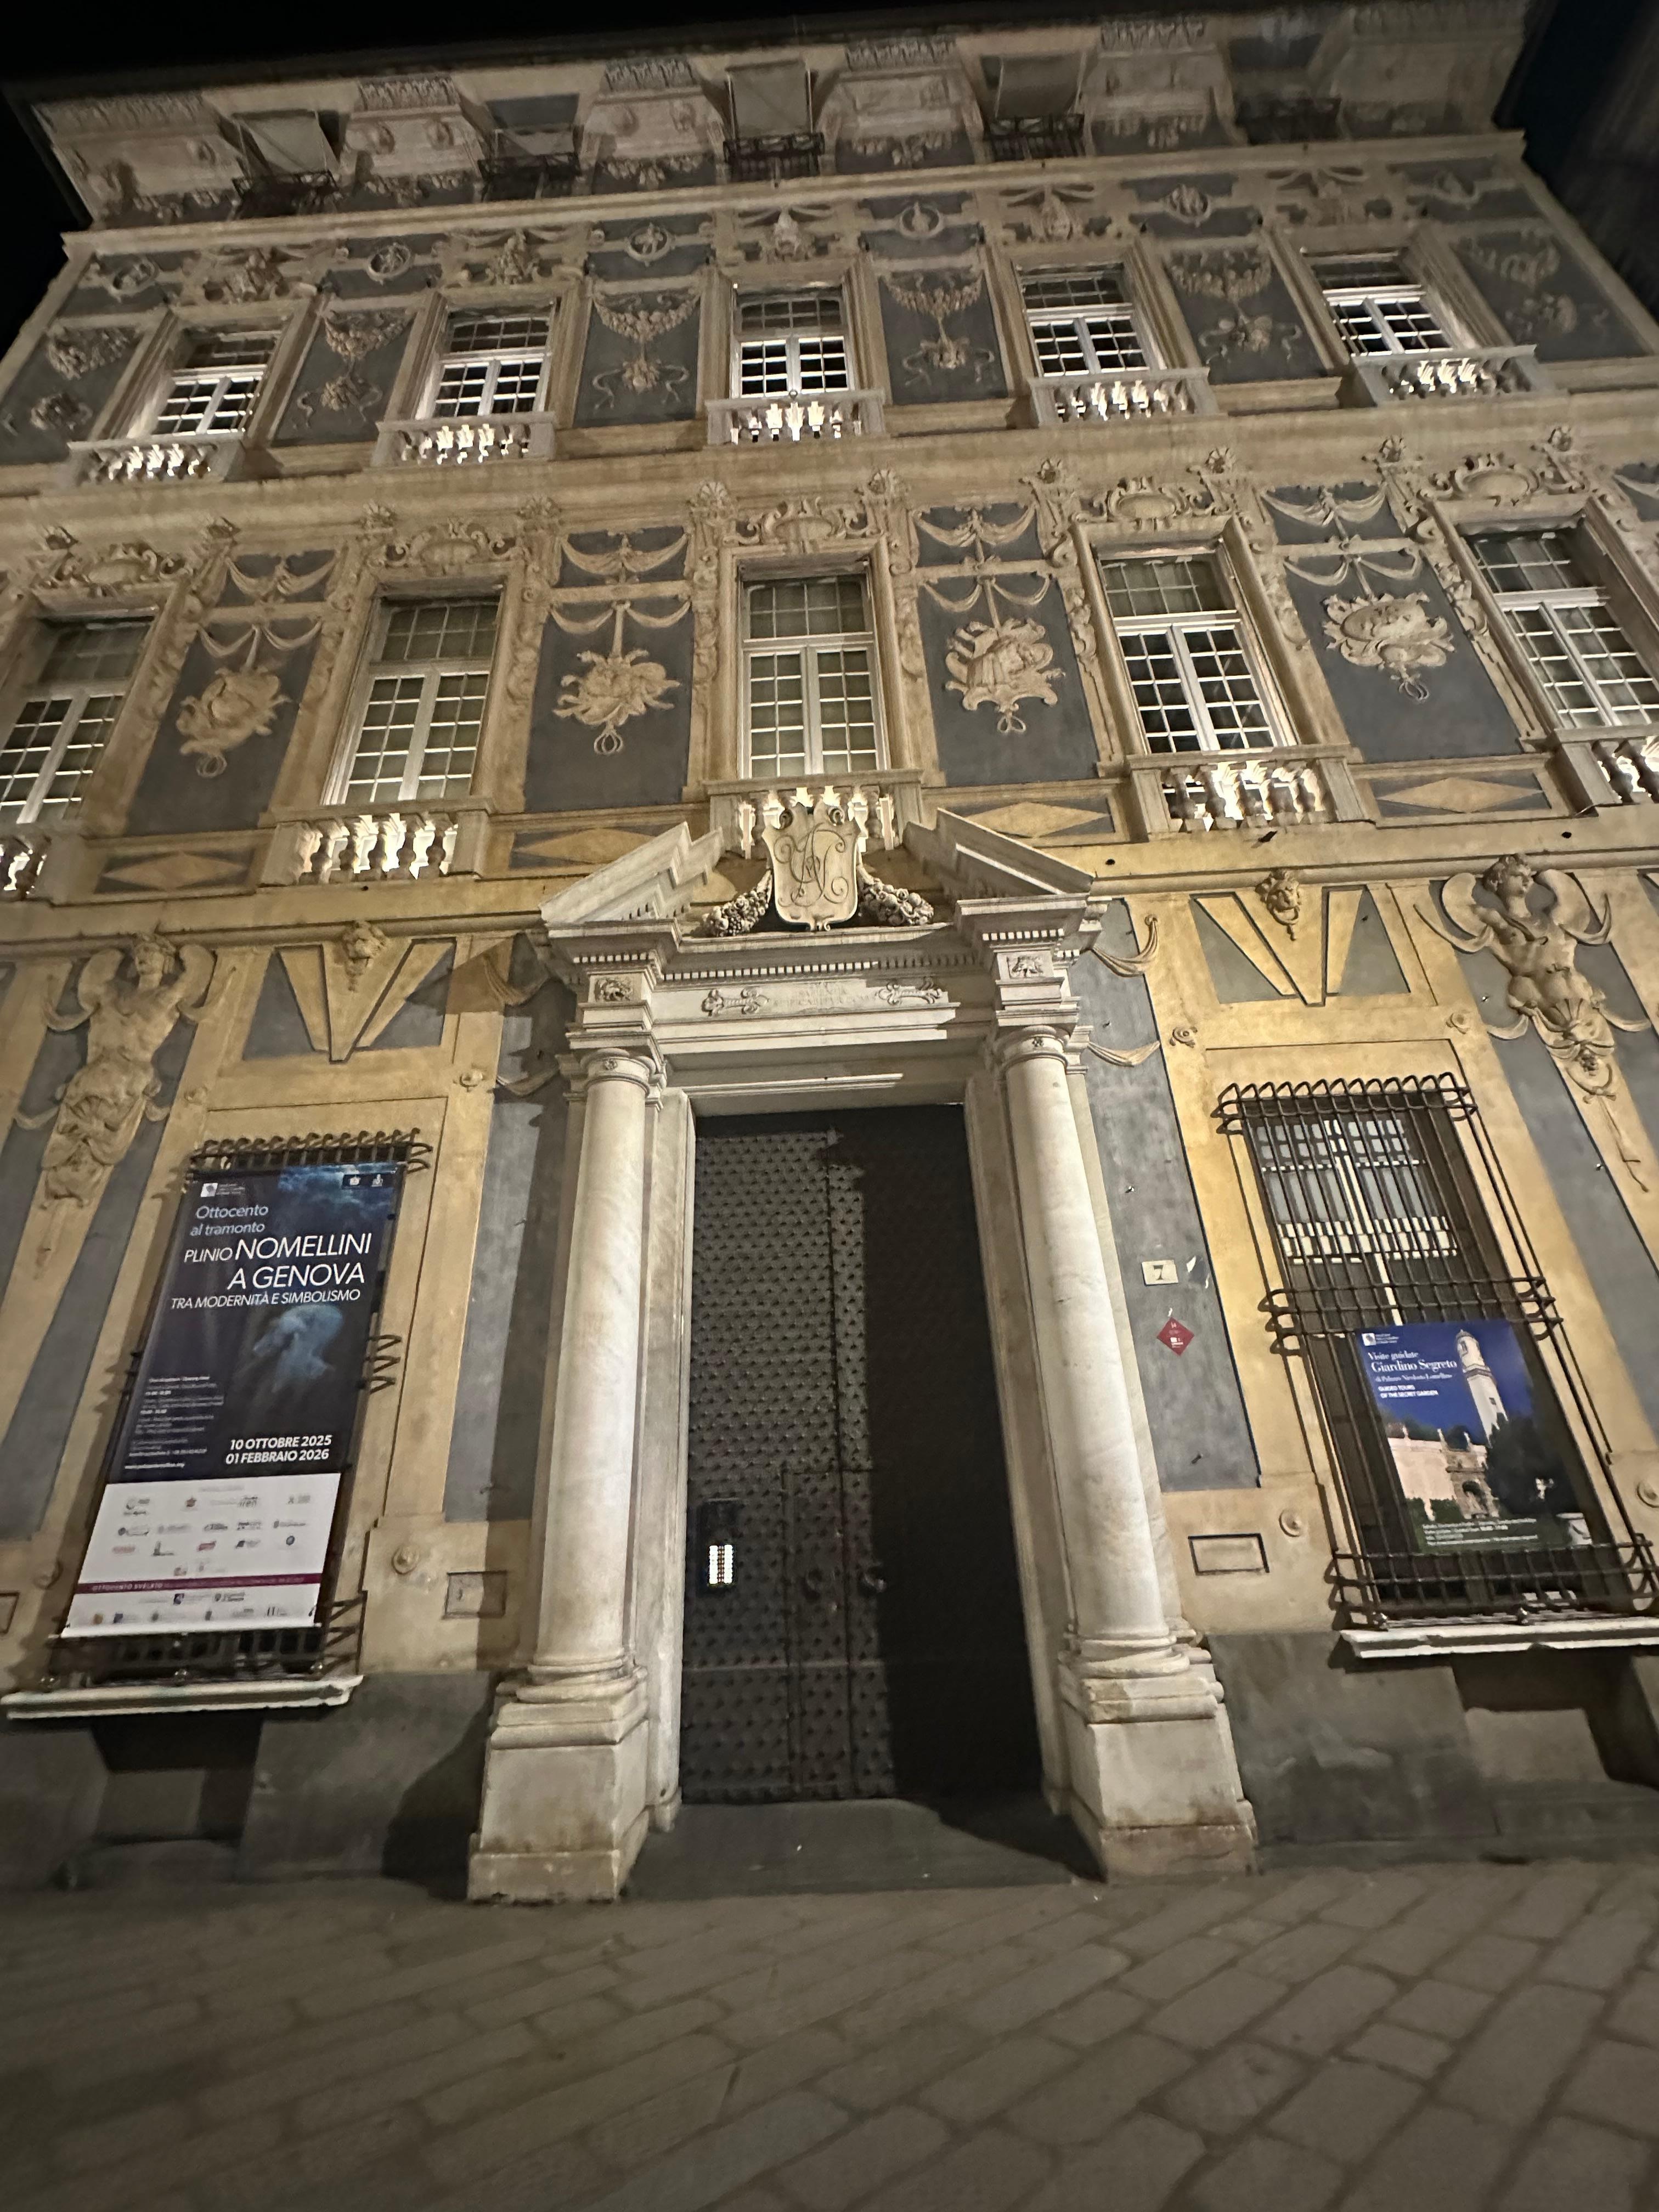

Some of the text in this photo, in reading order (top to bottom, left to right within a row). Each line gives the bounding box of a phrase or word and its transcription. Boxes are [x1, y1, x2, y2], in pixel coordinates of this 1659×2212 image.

[196, 1205, 269, 1219] Ottocento
[190, 1222, 266, 1236] al tramonto
[184, 1233, 372, 1262] PLINIO NOMELLINI
[227, 1262, 364, 1290] A GENOVA
[1153, 1265, 1164, 1280] 7
[171, 1289, 360, 1309] TRA MODERNITÀ E SIMBOLISMO
[1371, 1359, 1457, 1373] Giardino Segreto
[230, 1434, 332, 1451] 10 OTTOBRE 2025
[225, 1448, 329, 1465] 01 FEBBRAIO 2026
